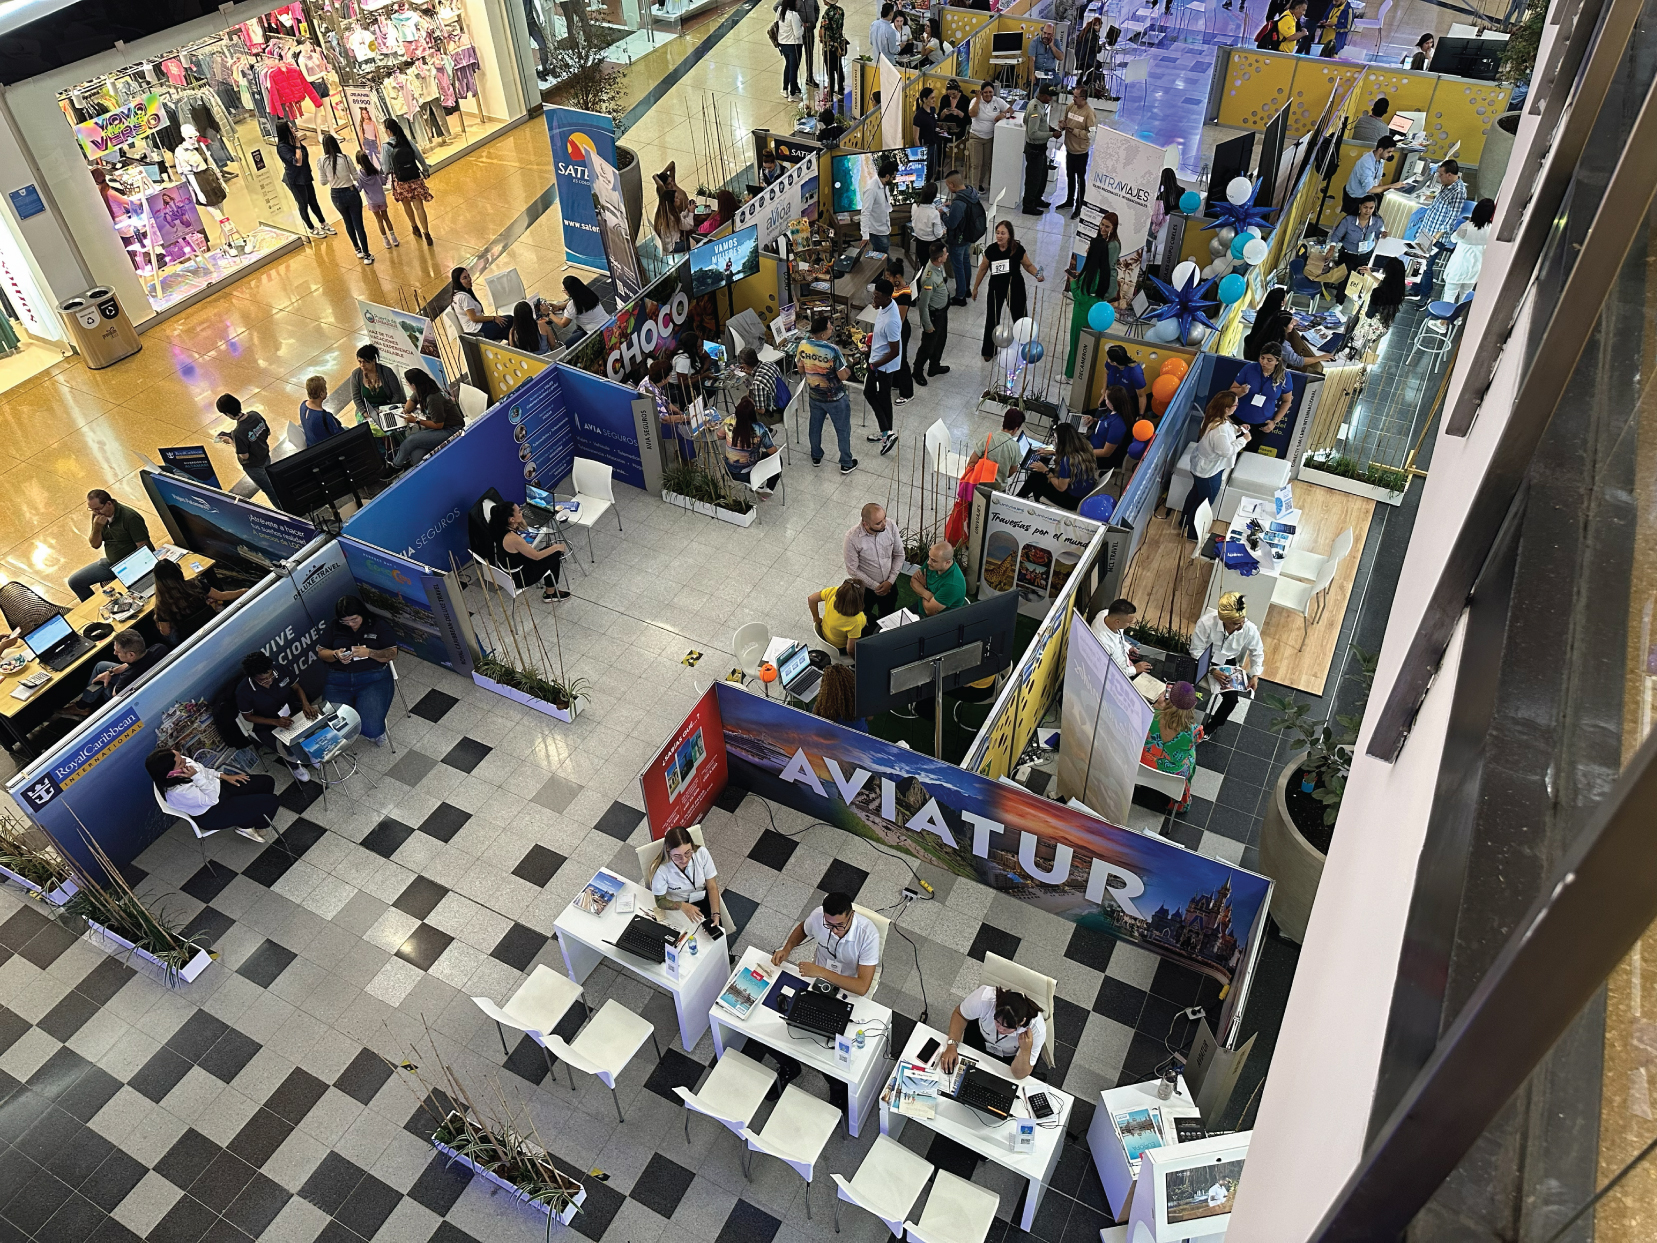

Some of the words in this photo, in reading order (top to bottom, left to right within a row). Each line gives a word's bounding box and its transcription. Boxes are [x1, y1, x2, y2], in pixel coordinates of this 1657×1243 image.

[1093, 170, 1150, 202] INTRAVIAJES
[714, 237, 738, 254] VAMOS
[606, 283, 689, 383] CHOCÓ
[800, 350, 831, 364] CHOCÓ
[1078, 344, 1088, 380] DECAMERON
[642, 410, 652, 436] SEGUROS
[1304, 389, 1317, 426] INTERNACIONAL
[584, 422, 602, 434] AVIA
[602, 424, 639, 448] SEGUROS
[416, 508, 460, 549] SEGUROS
[990, 512, 1032, 532] Travesías
[1032, 526, 1049, 536] por
[1053, 532, 1063, 542] el
[1111, 541, 1119, 560] TRAVEL
[317, 562, 341, 580] TRAVEL
[433, 584, 444, 603] TRAVEL
[260, 625, 295, 657] VIVE
[55, 712, 136, 780] RoyalCaribbean
[64, 724, 142, 787] INTERNATIONAL
[662, 738, 682, 766] ¿SABÍAS
[779, 747, 1148, 922] AVIATUR
